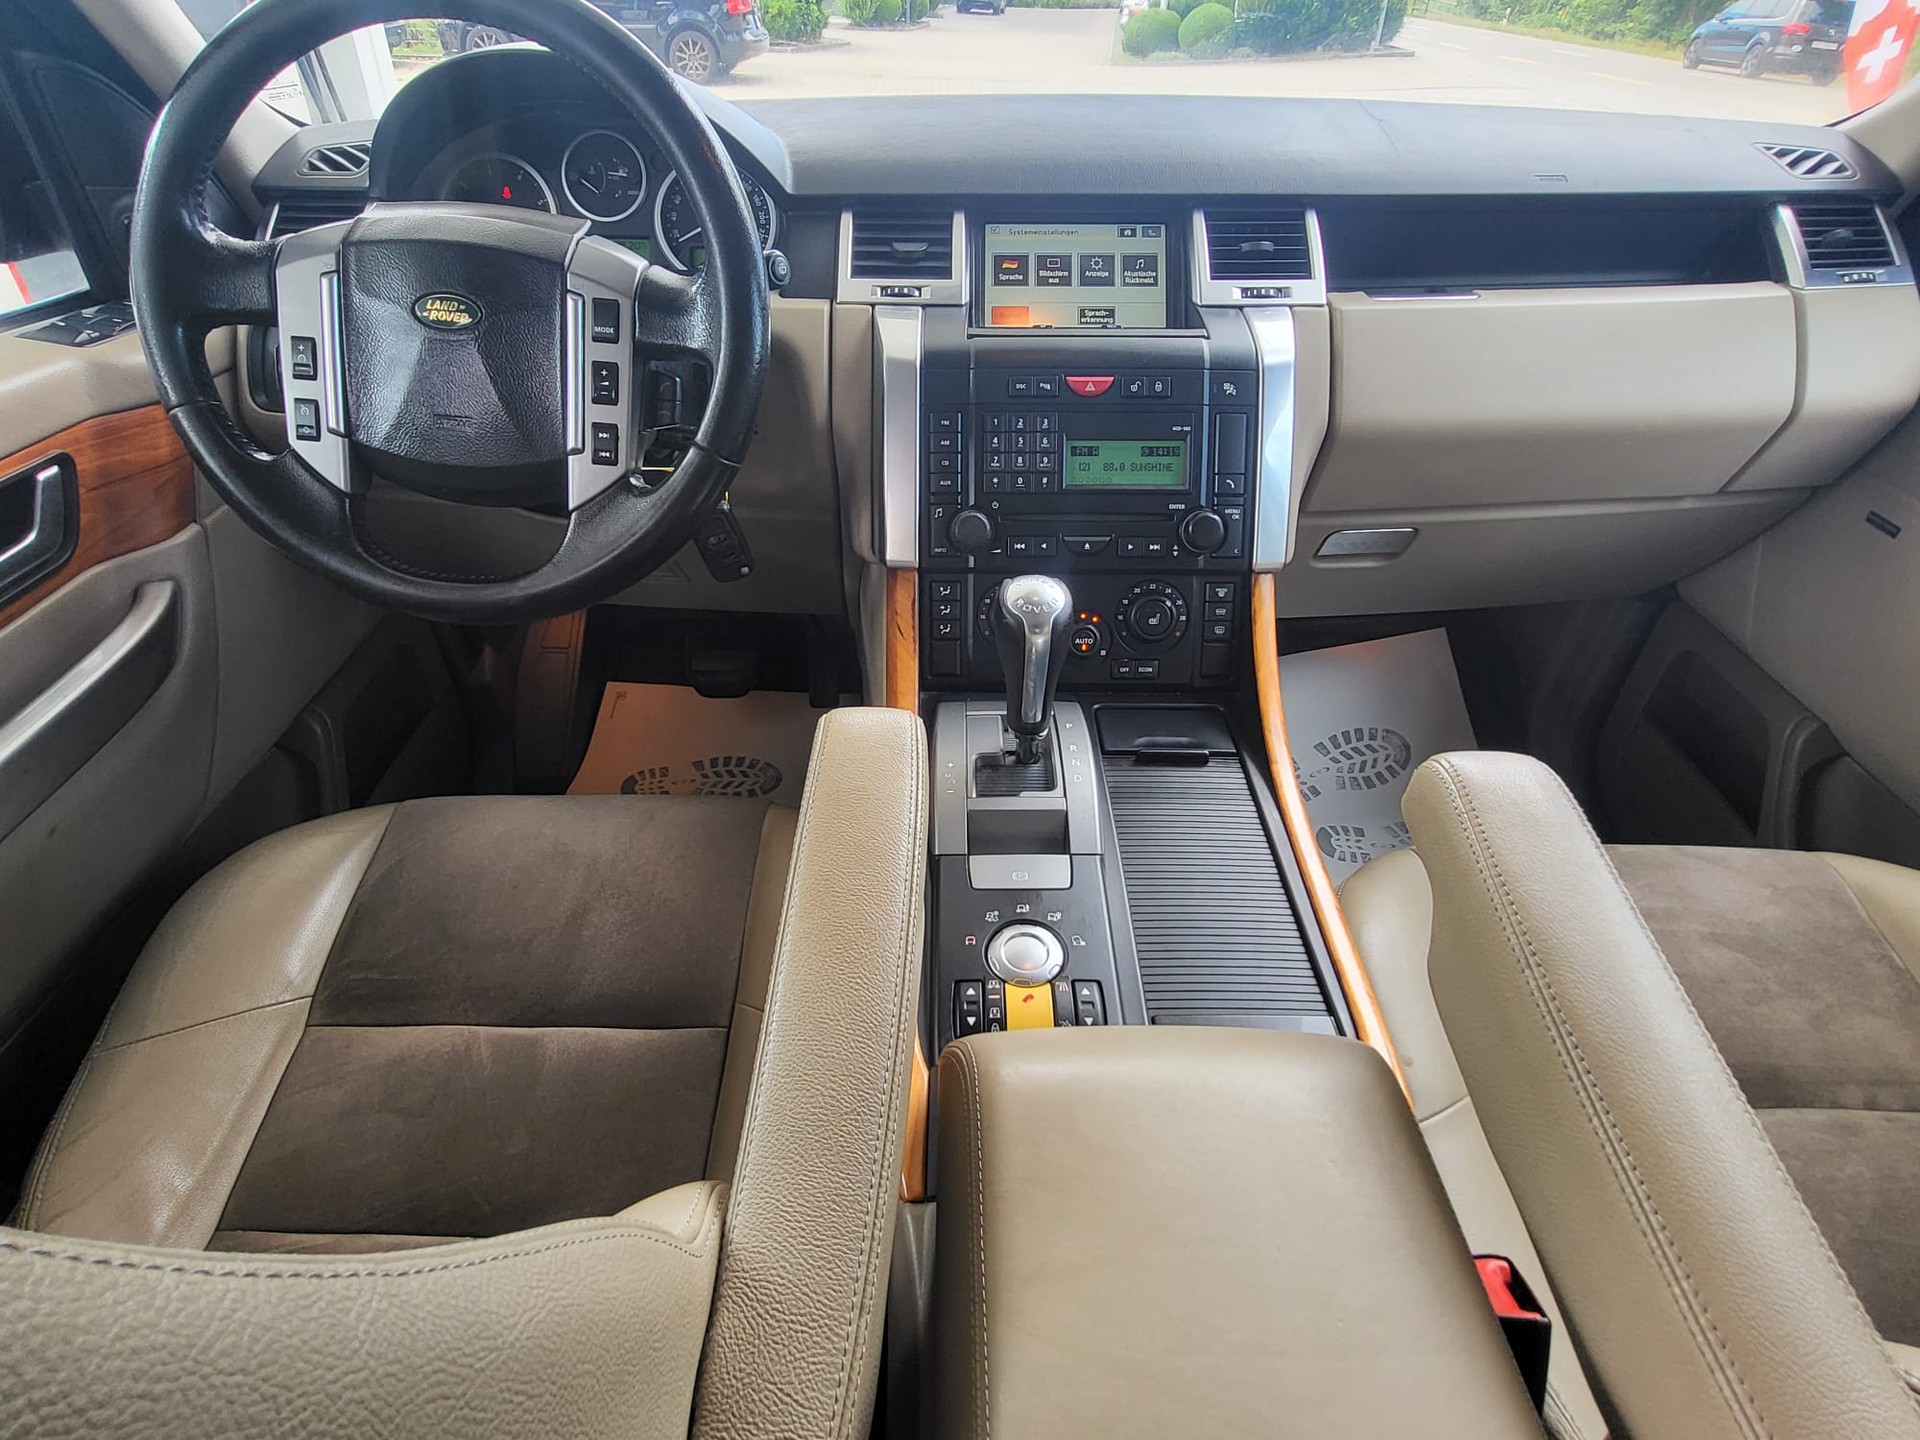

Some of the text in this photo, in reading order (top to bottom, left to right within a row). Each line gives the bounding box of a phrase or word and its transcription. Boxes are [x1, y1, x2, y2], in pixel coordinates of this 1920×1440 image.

[758, 211, 766, 225] 200
[1008, 228, 1079, 236] Systemeinstellungen
[998, 274, 1023, 282] Sprache
[1085, 270, 1109, 278] Anzeige
[426, 299, 459, 311] LAND
[429, 310, 470, 323] ROVER
[594, 326, 615, 334] MODE
[993, 418, 998, 426] 1
[1018, 418, 1024, 426] 2
[1043, 418, 1048, 426] 3
[1017, 456, 1023, 464] 8
[1042, 456, 1048, 464] 9
[1130, 462, 1174, 472] SUNSHINE
[1017, 476, 1023, 484] 0
[1069, 744, 1078, 752] R
[1072, 758, 1080, 766] N
